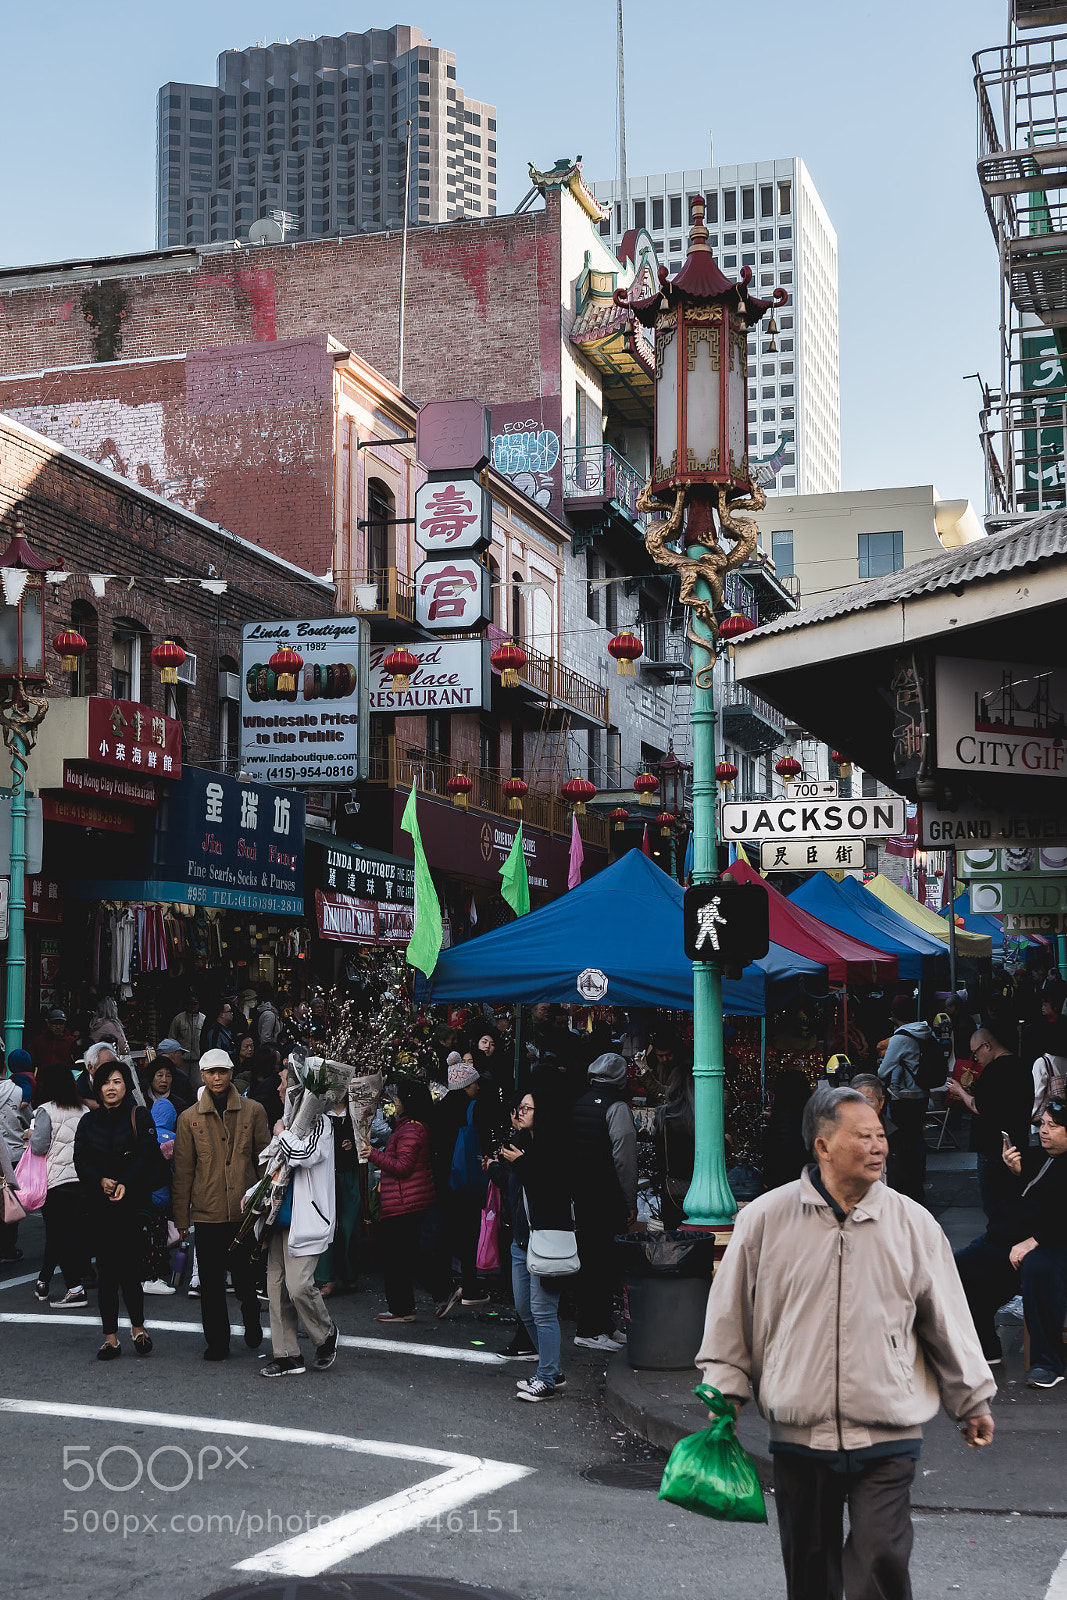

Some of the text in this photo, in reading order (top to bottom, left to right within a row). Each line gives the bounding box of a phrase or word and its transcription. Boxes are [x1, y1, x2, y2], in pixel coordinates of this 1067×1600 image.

[247, 622, 357, 639] Linda Boutique
[305, 642, 326, 651] 1982
[243, 712, 358, 728] Wholesale Price
[256, 729, 344, 744] to the Public
[99, 739, 173, 773] 小菜海鮮館
[247, 752, 357, 763] www.lindaboutique.com
[266, 765, 354, 781] (415)-954-0816
[66, 768, 156, 801] Hong Kong Clay Pot Restaurant
[793, 784, 818, 797] 700
[730, 805, 894, 834] JACKSON
[929, 820, 992, 841] GRAND
[202, 833, 297, 872] Jin Sui Fang
[327, 850, 352, 870] LINDA
[355, 857, 396, 879] BOUTIQUE
[187, 860, 207, 879] Fine
[237, 869, 258, 886] Socks
[261, 871, 268, 887] &
[270, 873, 296, 892] Purses
[187, 887, 207, 902] #956
[356, 910, 376, 936] SALE
[1006, 913, 1051, 930] Fine
